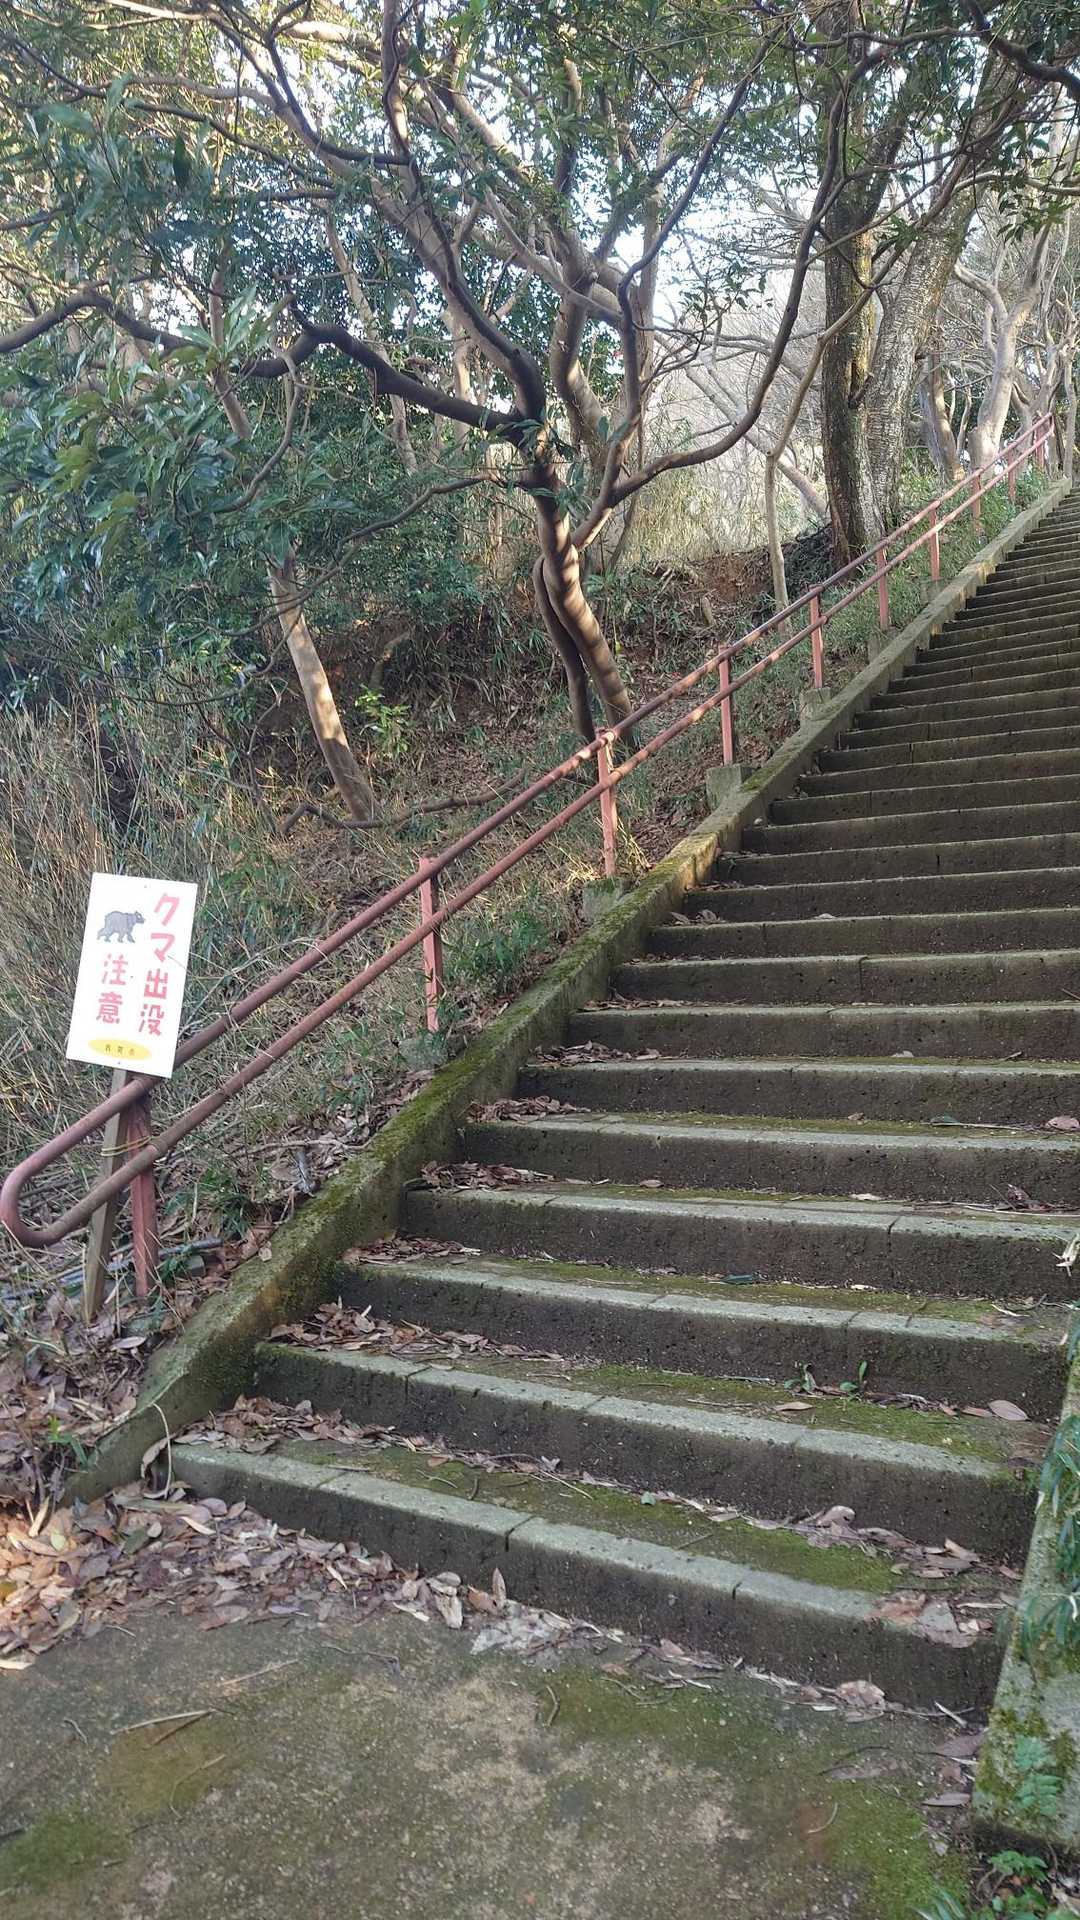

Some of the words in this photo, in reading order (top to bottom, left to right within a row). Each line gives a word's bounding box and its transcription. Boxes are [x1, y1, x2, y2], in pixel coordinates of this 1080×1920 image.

[96, 953, 129, 1025] 注意
[138, 892, 180, 1036] クマ出没
